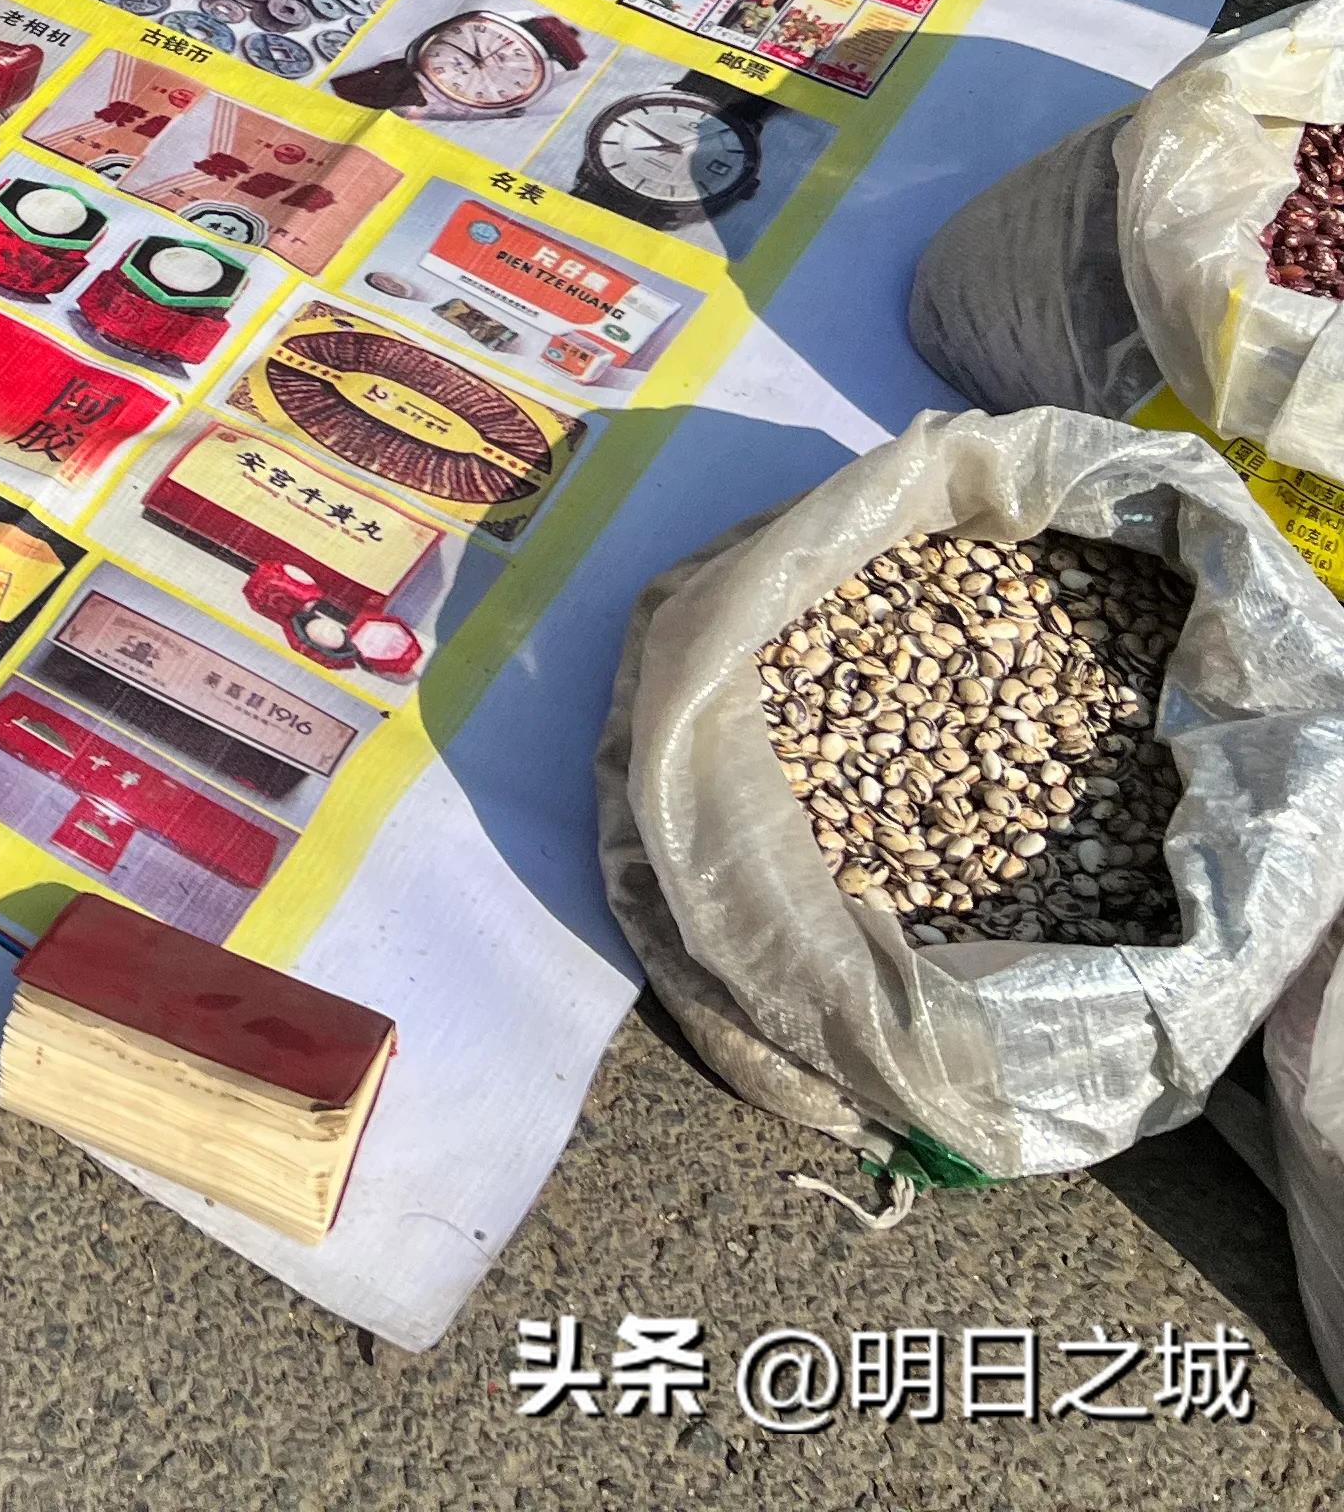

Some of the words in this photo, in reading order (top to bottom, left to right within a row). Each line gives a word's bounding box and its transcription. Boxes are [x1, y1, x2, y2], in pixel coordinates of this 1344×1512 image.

[137, 27, 212, 64] 古钱币
[713, 50, 774, 81] 邮票
[486, 170, 550, 204] 名表
